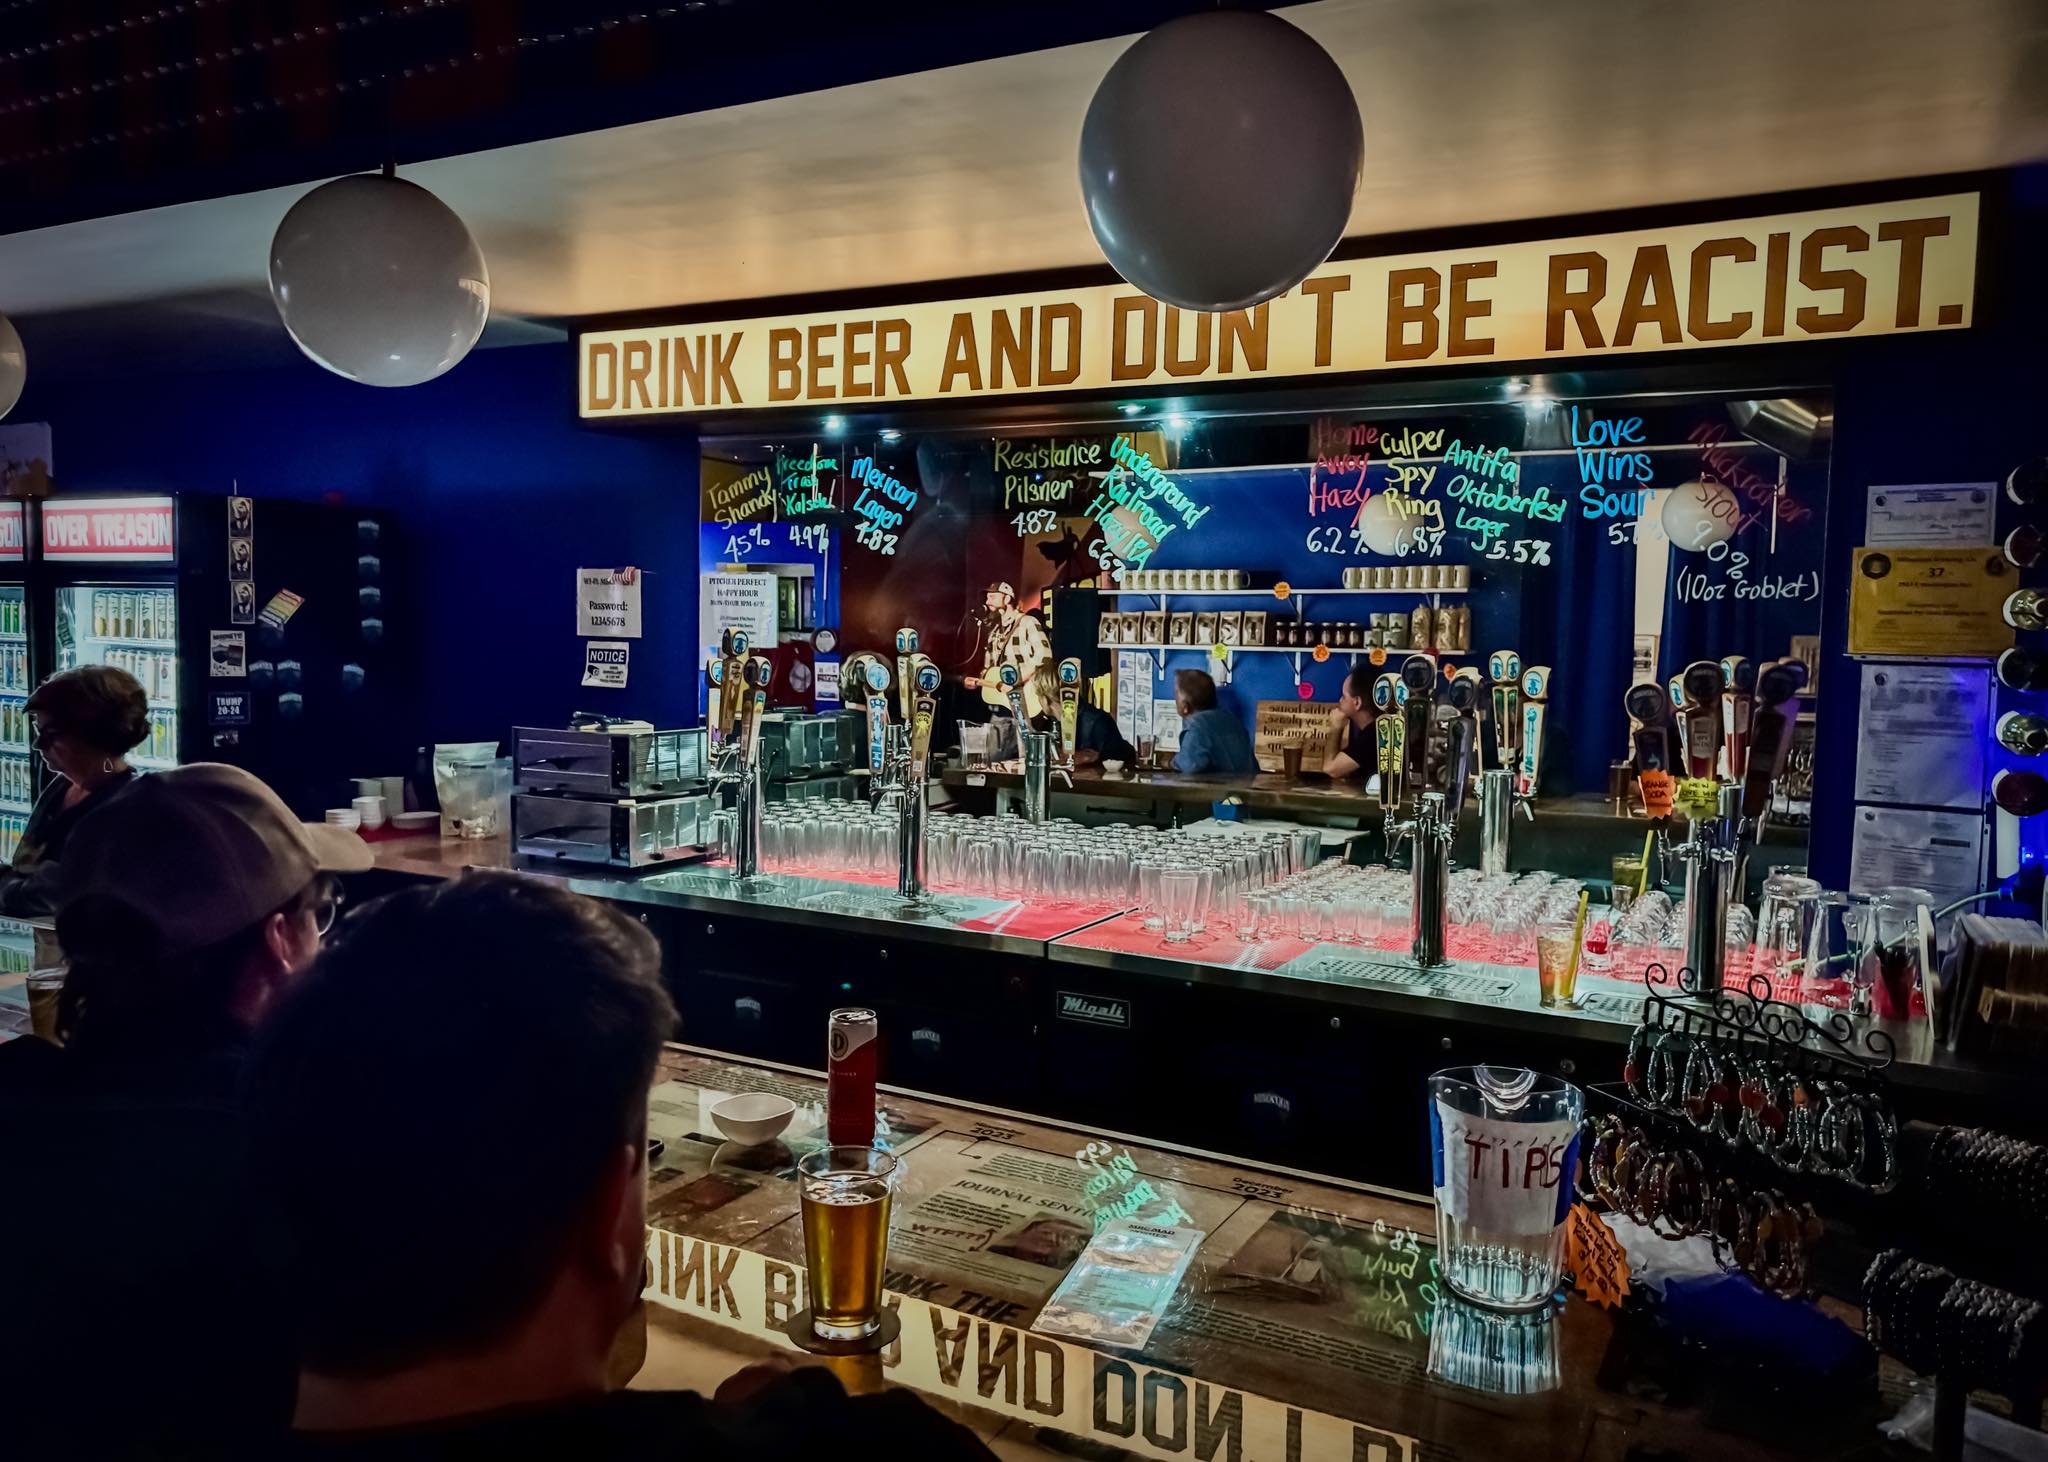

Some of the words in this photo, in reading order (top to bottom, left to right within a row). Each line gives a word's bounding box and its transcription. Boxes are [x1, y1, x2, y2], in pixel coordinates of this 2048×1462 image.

[587, 331, 744, 411] DRINK
[768, 317, 912, 402] BEER
[939, 301, 1082, 394] AND
[1385, 260, 1498, 362] BE
[1545, 215, 1964, 352] RACIST.
[1315, 416, 1379, 449] Home
[1571, 405, 1647, 447] Love
[994, 438, 1102, 472] Resistance
[1443, 439, 1518, 483] Antifa
[1576, 446, 1654, 484] Wins
[706, 466, 771, 510] Tammy
[851, 456, 919, 511] Mexican
[1004, 475, 1074, 510] Pilsner
[1110, 435, 1211, 530] Underground
[1384, 457, 1437, 495] Spy
[714, 488, 777, 530] Shandy
[852, 488, 903, 533] Lager
[1099, 463, 1177, 543] Railroad
[1310, 481, 1370, 528] Hazy
[1382, 487, 1445, 532] Ring
[1446, 474, 1567, 523] Oktoberfest
[1579, 484, 1655, 520] Sour
[46, 513, 89, 547] OVER
[92, 511, 171, 547] TREASON
[1455, 506, 1510, 551] Lager
[1486, 539, 1552, 567] 5.5%
[709, 577, 737, 586] PITCHER
[737, 578, 767, 586] PERFECT
[1928, 567, 1945, 578] 37
[589, 600, 628, 611] Password:
[739, 589, 759, 598] HOUR
[591, 616, 626, 627] 12345678
[590, 650, 625, 663] NOTICE
[216, 697, 243, 706] TRUMP
[1062, 996, 1125, 1021] Migali
[969, 1125, 1014, 1139] 2023
[1464, 1136, 1565, 1189] TIPS
[952, 1179, 1033, 1206] JOURNAL
[1231, 1183, 1283, 1199] 2023
[1232, 1176, 1294, 1194] December
